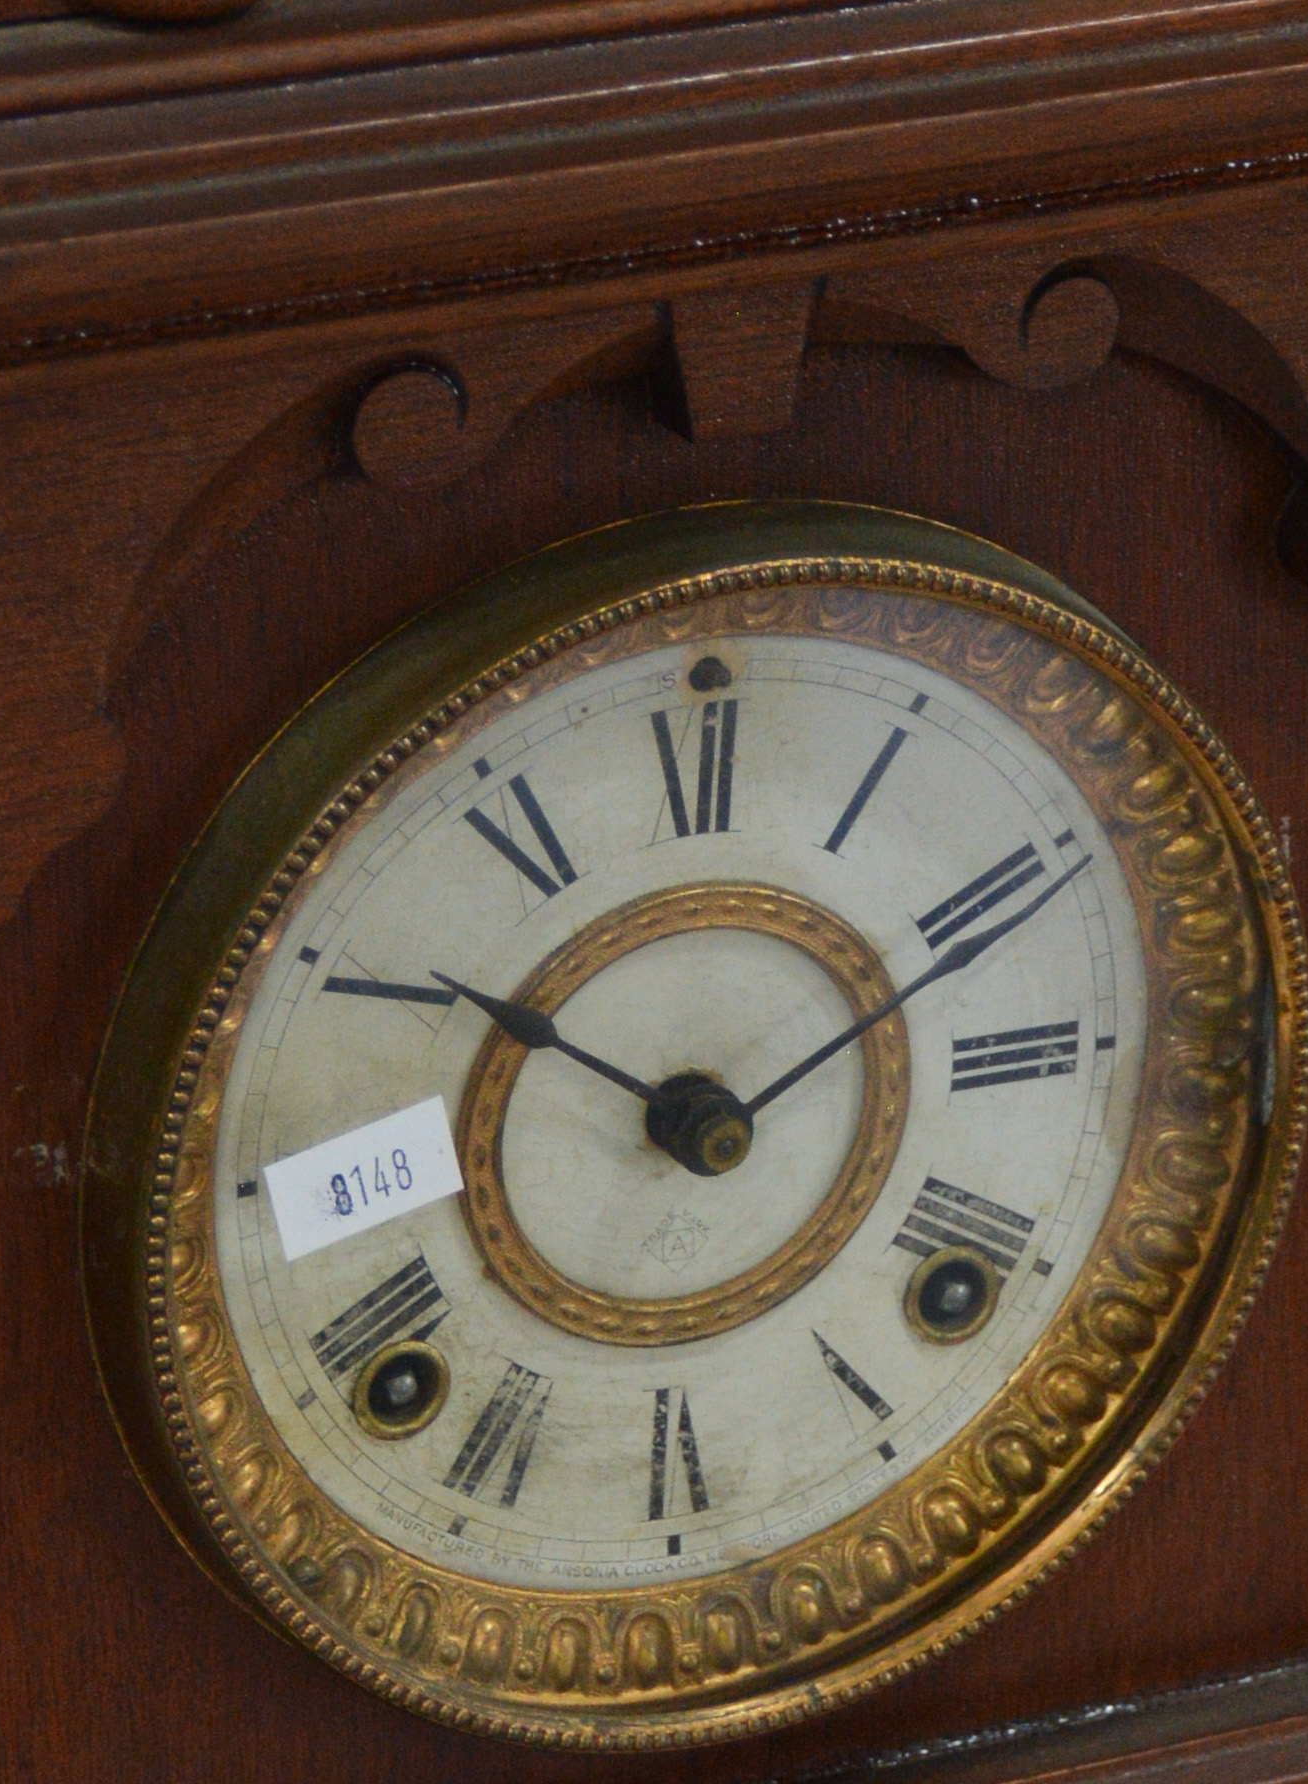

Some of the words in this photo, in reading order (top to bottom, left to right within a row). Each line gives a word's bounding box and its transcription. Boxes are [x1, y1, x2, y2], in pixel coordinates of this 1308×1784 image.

[639, 698, 749, 849] XII
[812, 721, 918, 859] I
[452, 766, 590, 927] XI
[909, 833, 1051, 960] II
[315, 941, 466, 1042] X
[948, 1010, 1079, 1104] III
[811, 1327, 905, 1448] V
[642, 1385, 711, 1521] VI
[375, 1501, 485, 1560] MANUFACTURED
[492, 1552, 511, 1568] BY
[518, 1558, 542, 1574] THE
[550, 1562, 619, 1579] ANSONIA
[623, 1560, 675, 1577] CLOCK
